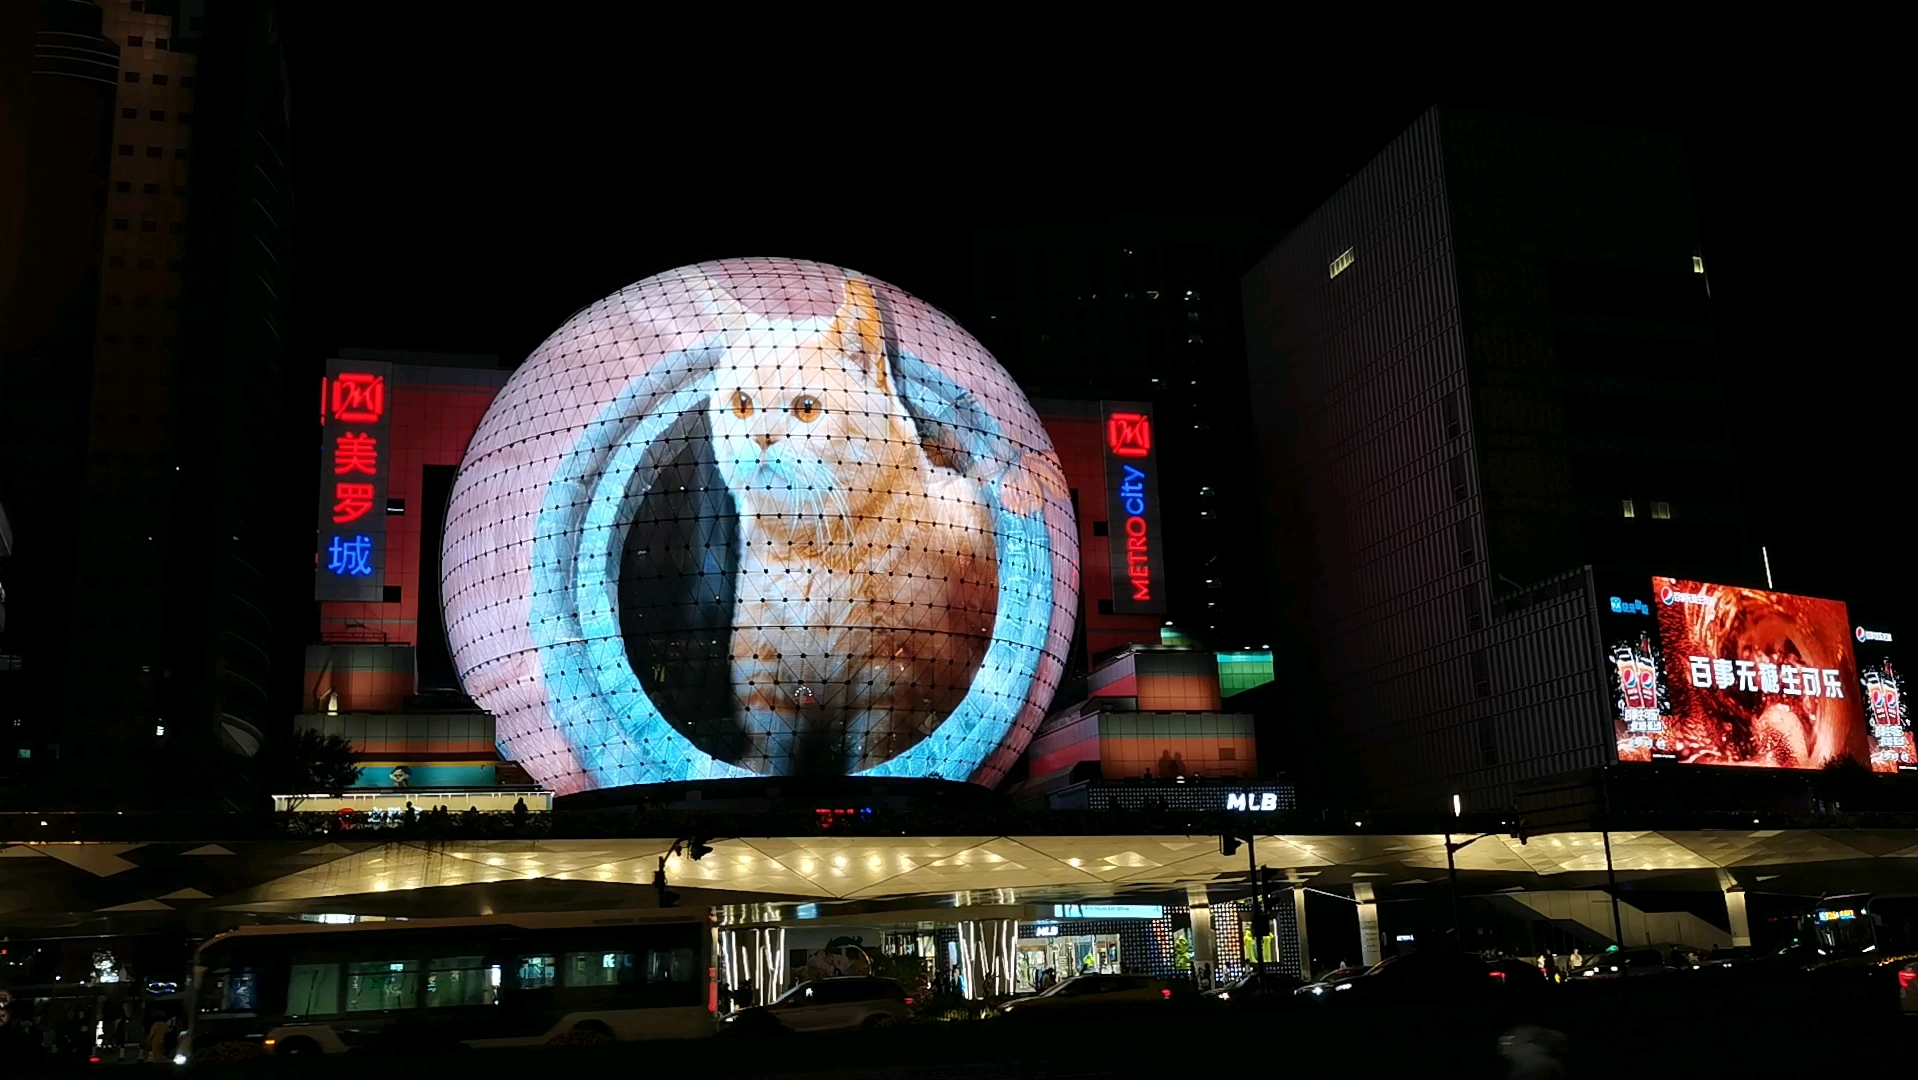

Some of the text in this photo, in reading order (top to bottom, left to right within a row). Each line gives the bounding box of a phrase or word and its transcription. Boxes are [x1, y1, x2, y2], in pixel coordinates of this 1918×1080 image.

[328, 431, 378, 576] 美罗城
[1121, 464, 1151, 601] METROcity
[1688, 655, 1845, 699] 百事无糖生可乐
[1226, 792, 1278, 811] MLB
